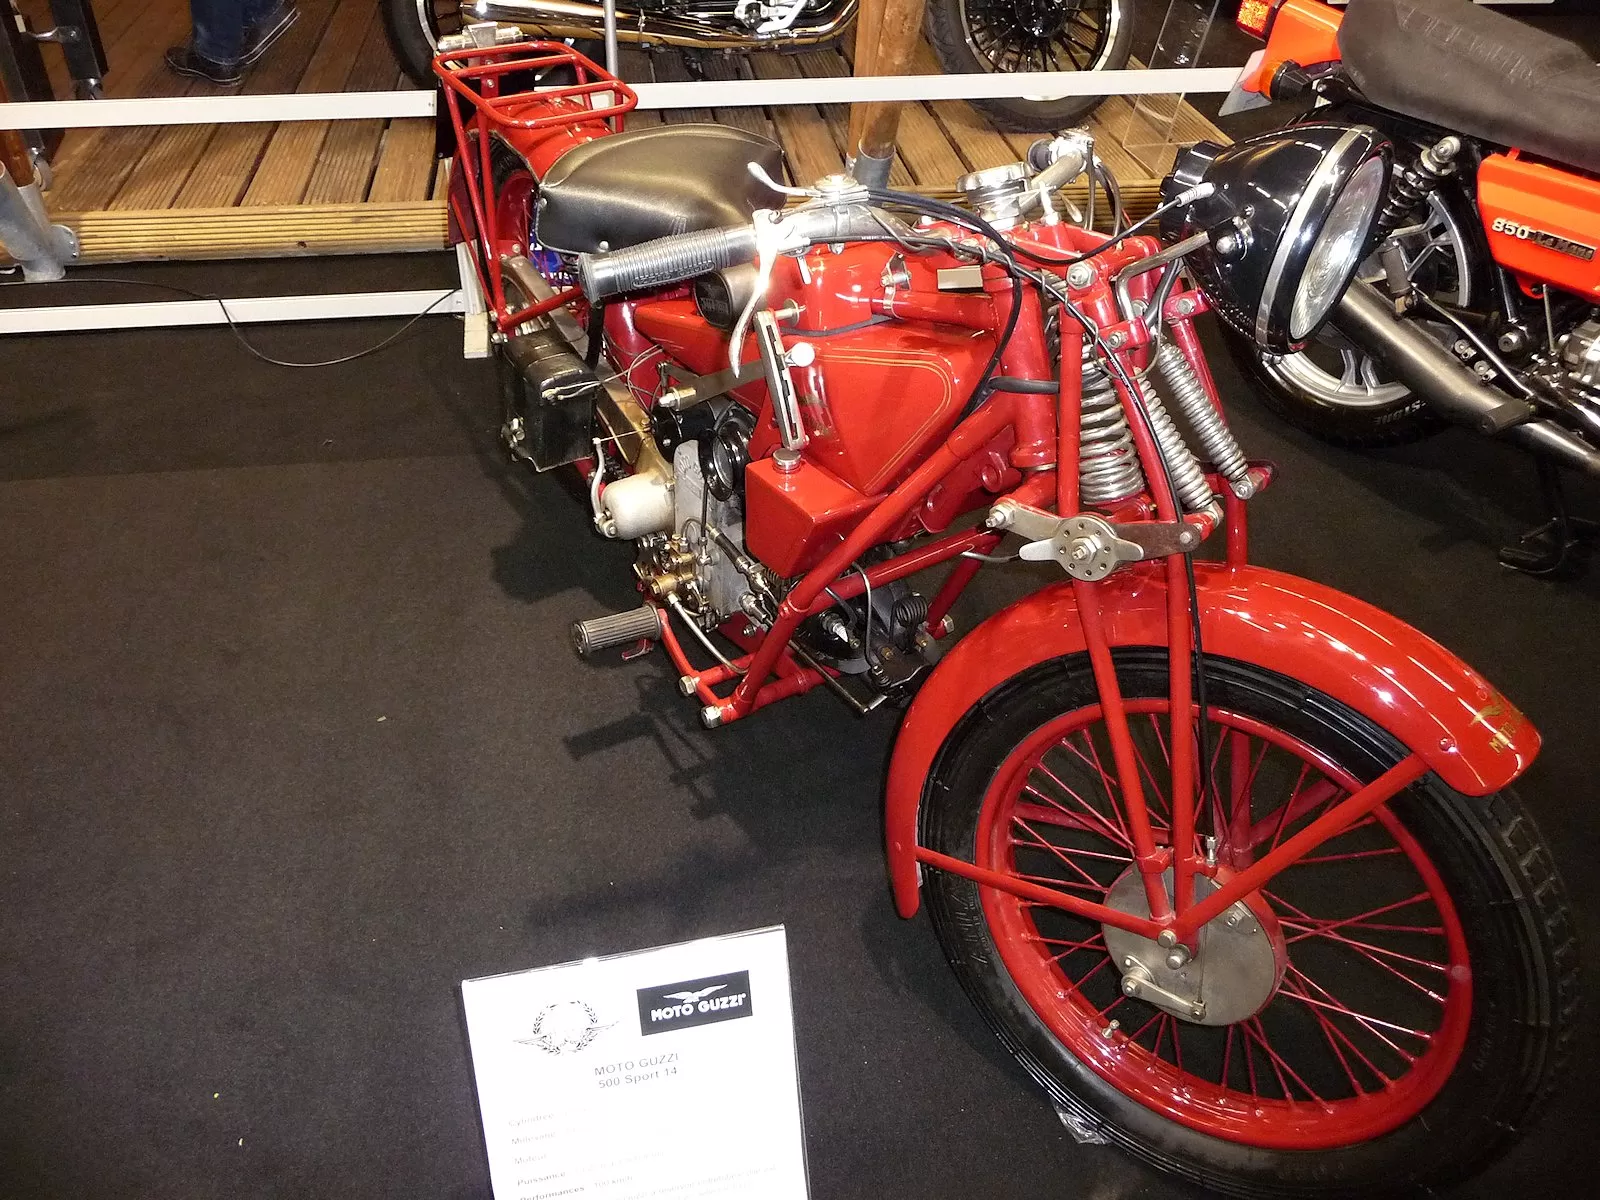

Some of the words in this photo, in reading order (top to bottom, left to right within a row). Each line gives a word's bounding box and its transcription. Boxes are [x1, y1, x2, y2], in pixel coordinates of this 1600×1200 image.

[1492, 217, 1529, 240] 850
[651, 1003, 694, 1021] MOTO
[698, 993, 746, 1013] GUZZI
[594, 1060, 635, 1076] MOTO
[638, 1052, 679, 1068] GUZZI
[598, 1076, 621, 1089] 500
[624, 1070, 660, 1085] Sport
[665, 1066, 678, 1077] 14
